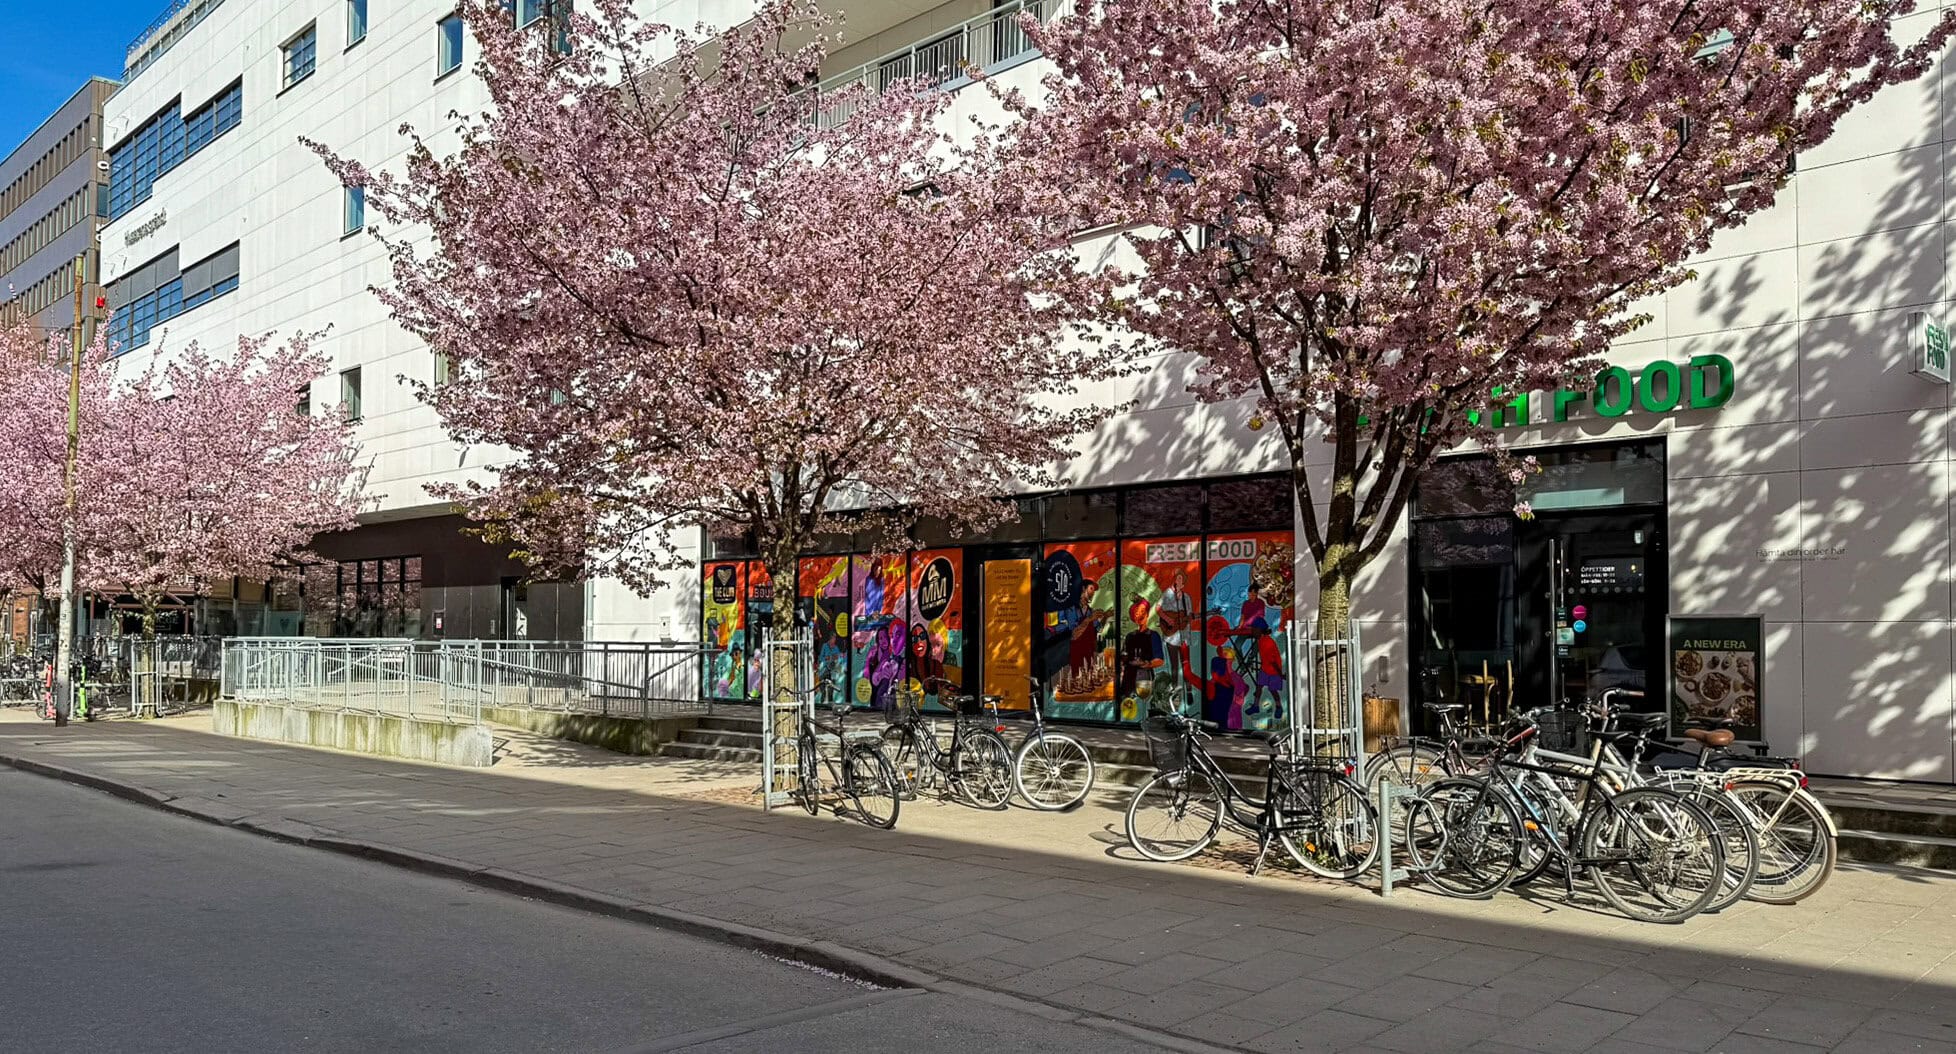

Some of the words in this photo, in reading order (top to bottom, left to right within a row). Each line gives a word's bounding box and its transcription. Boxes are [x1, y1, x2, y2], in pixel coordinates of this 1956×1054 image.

[1146, 543, 1201, 562] FRESH
[1208, 540, 1255, 559] FOOD
[922, 577, 947, 605] MM
[1683, 640, 1692, 649] A
[1694, 640, 1721, 649] NEW
[1723, 640, 1747, 649] ERA
